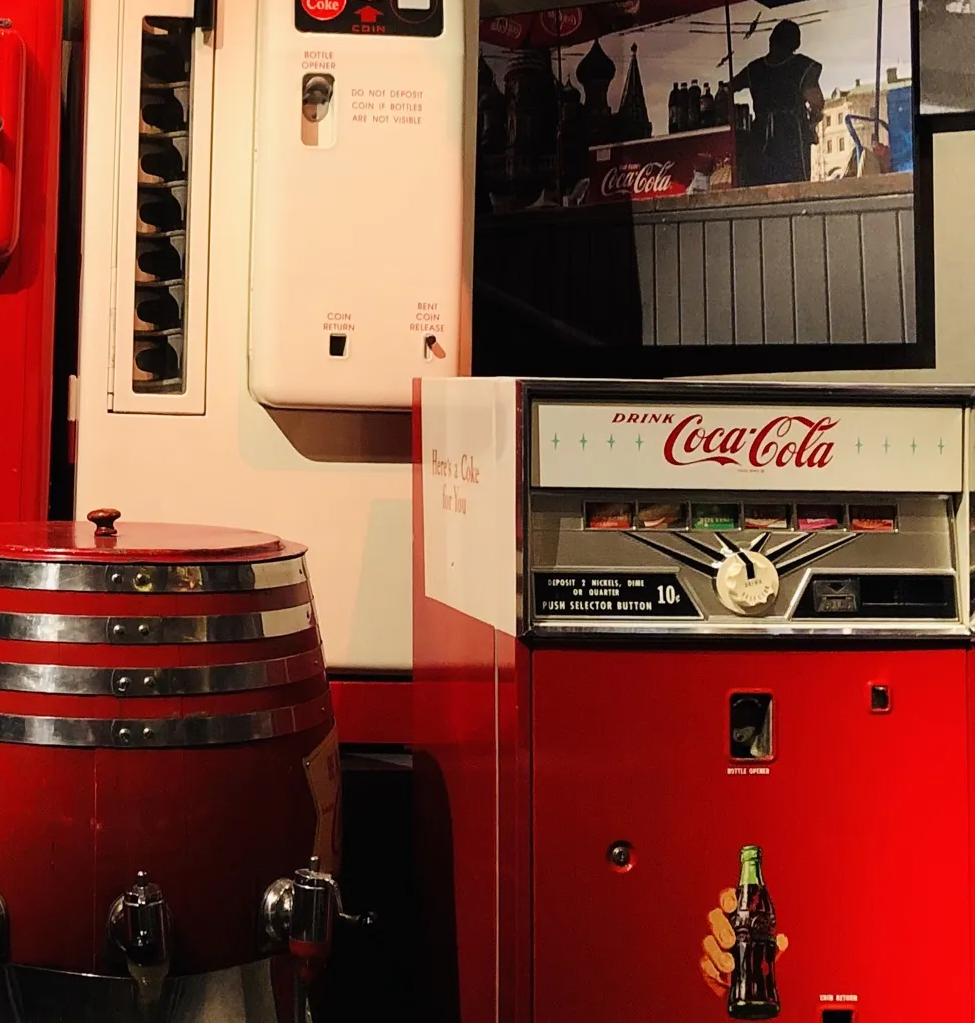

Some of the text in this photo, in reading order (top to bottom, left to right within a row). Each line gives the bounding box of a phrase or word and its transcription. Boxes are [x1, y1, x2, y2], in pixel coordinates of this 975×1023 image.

[352, 24, 386, 33] COIN
[304, 51, 333, 60] BOTTLE
[301, 61, 336, 70] OPENER
[351, 89, 423, 99] DO NOT DEPOSIT
[352, 102, 423, 112] COIN IF BOTTLES
[352, 115, 422, 125] ARE NOT VISIBLE
[601, 161, 676, 197] Coca-Cola
[417, 302, 438, 311] BENT
[327, 312, 352, 321] COIN
[416, 312, 440, 321] COIN
[323, 323, 355, 331] RETURN
[410, 323, 444, 333] RELEASE
[612, 412, 676, 425] DRINK
[663, 414, 841, 470] Coca-Cola
[432, 449, 452, 477] Here's
[461, 454, 480, 484] Coke
[442, 483, 467, 515] for You
[548, 579, 575, 587] DEPOSIT
[627, 579, 645, 587] DIME
[657, 584, 681, 605] 10¢
[542, 601, 652, 611] PUSH SELECTOR BUTTON
